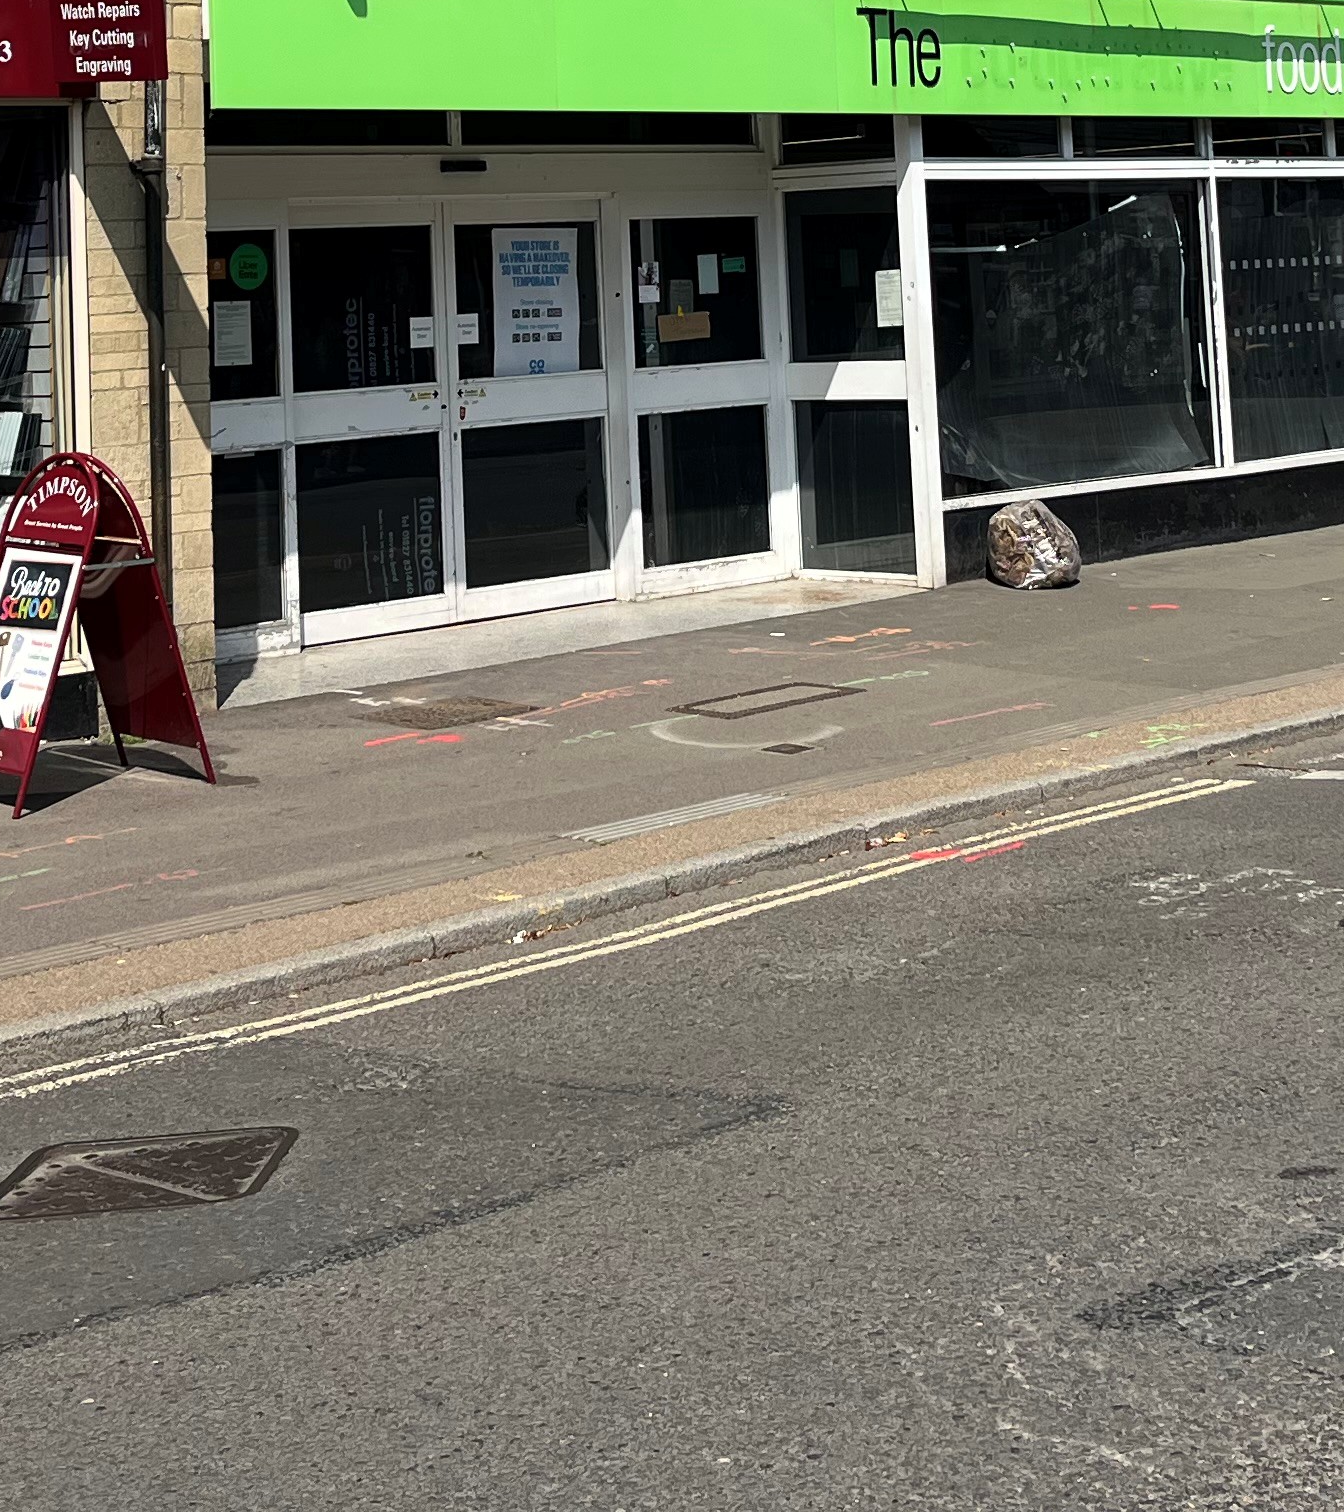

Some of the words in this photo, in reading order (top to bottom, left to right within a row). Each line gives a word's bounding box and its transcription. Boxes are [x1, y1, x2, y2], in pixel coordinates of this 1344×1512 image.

[60, 3, 95, 20] Watch
[97, 1, 140, 21] Repairs
[69, 30, 89, 48] Key
[92, 28, 134, 48] Cutting
[856, 7, 942, 88] The
[1262, 25, 1343, 94] food
[75, 55, 132, 77] Engraving
[27, 476, 94, 518] TIMPSON
[417, 496, 437, 592] florprote
[11, 566, 45, 600] Back
[44, 576, 60, 597] TO
[0, 595, 58, 620] SCHOOL
